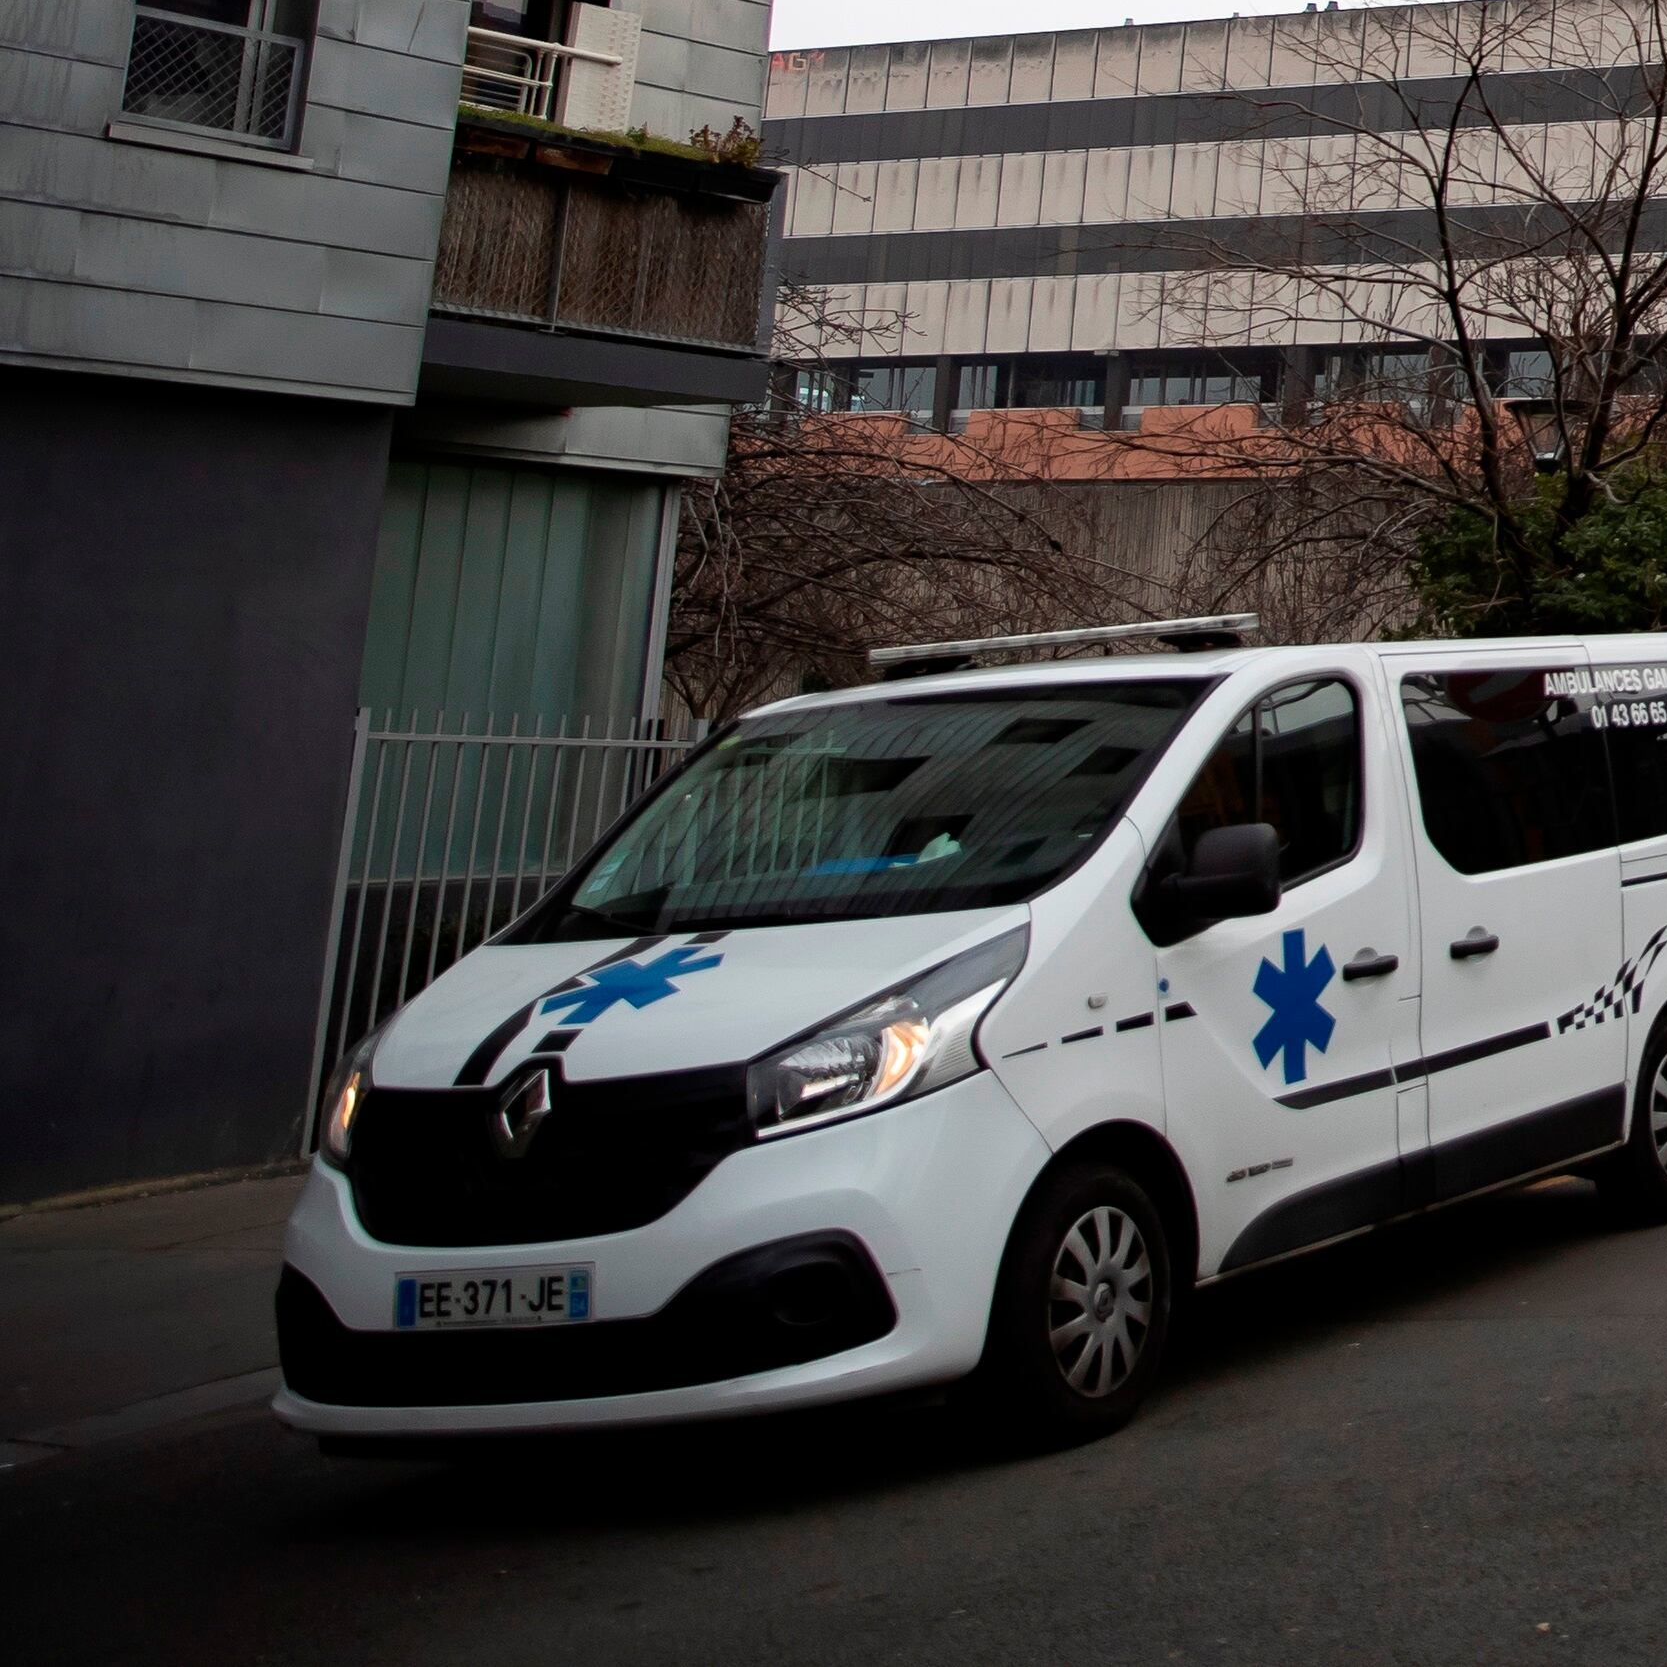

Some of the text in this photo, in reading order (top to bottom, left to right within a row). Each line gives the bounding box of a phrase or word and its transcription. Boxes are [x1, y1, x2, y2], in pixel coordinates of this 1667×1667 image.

[1544, 668, 1643, 695] AMBULANCES
[1591, 705, 1608, 728] 01
[1612, 704, 1629, 726] 43
[1650, 701, 1667, 724] 65
